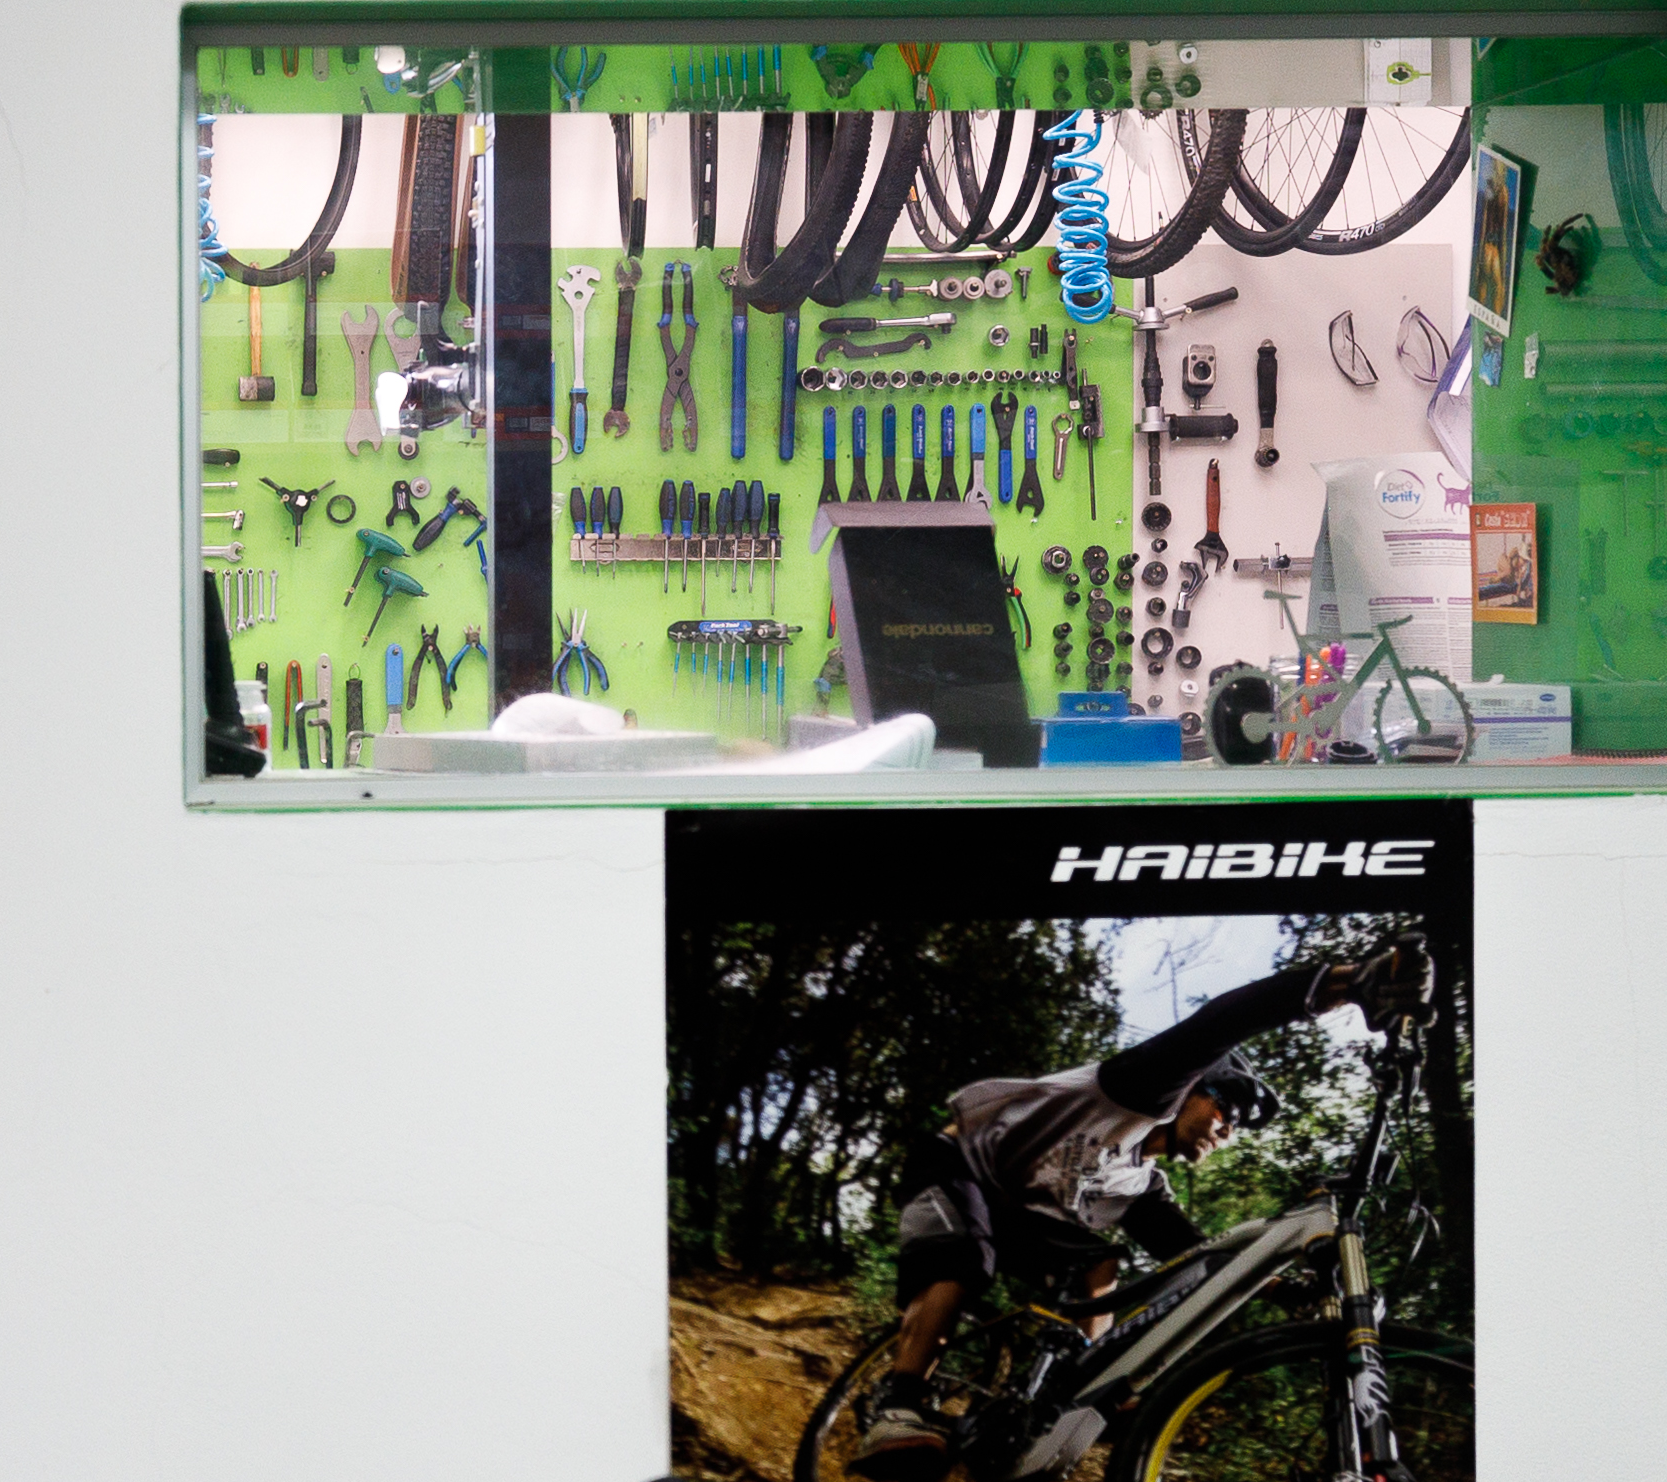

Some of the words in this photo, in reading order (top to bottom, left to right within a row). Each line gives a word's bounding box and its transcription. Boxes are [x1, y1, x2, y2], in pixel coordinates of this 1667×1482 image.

[1338, 223, 1375, 242] R470
[1387, 482, 1405, 491] Diet
[1382, 490, 1421, 504] Fortify
[881, 622, 995, 639] cannondale
[1050, 840, 1436, 883] HAIBIKE
